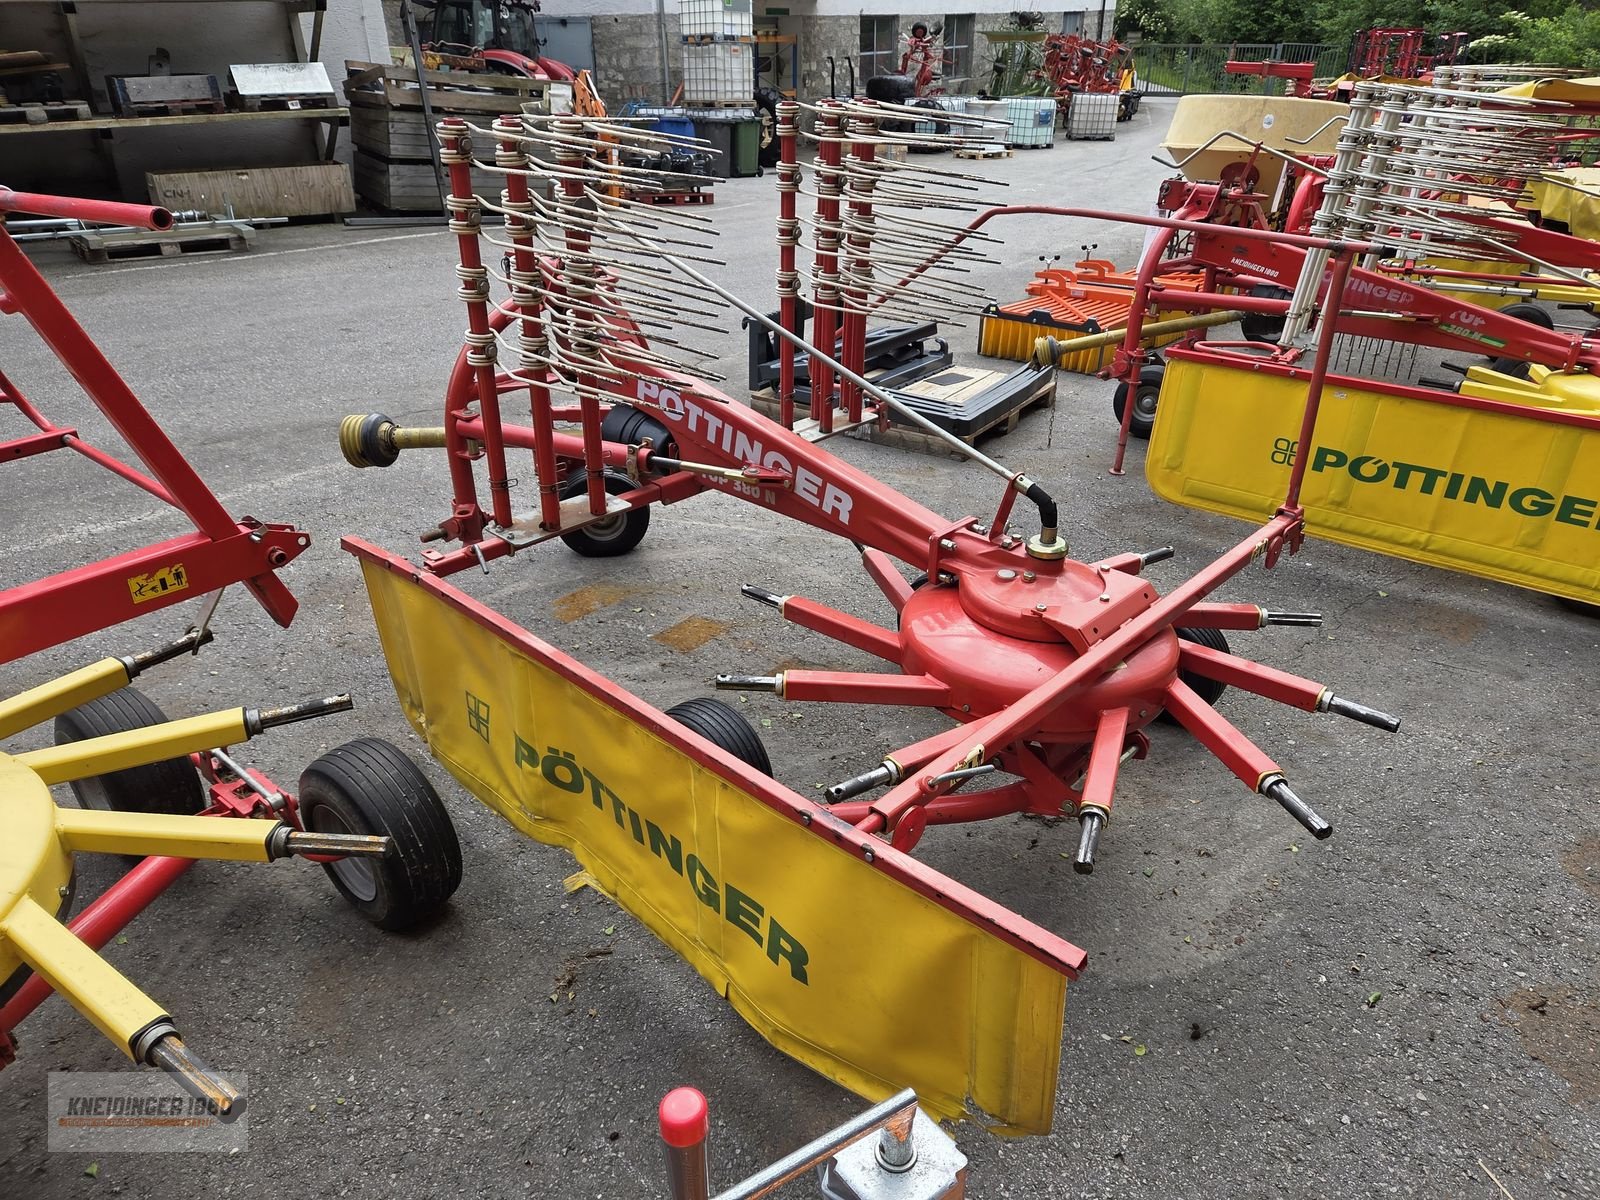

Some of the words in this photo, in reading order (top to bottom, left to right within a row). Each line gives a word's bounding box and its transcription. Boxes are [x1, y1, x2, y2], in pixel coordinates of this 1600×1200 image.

[733, 479, 760, 499] 380
[765, 488, 776, 505] N
[1311, 446, 1600, 531] PÖTTINGE
[514, 730, 809, 986] PÖTTINGER
